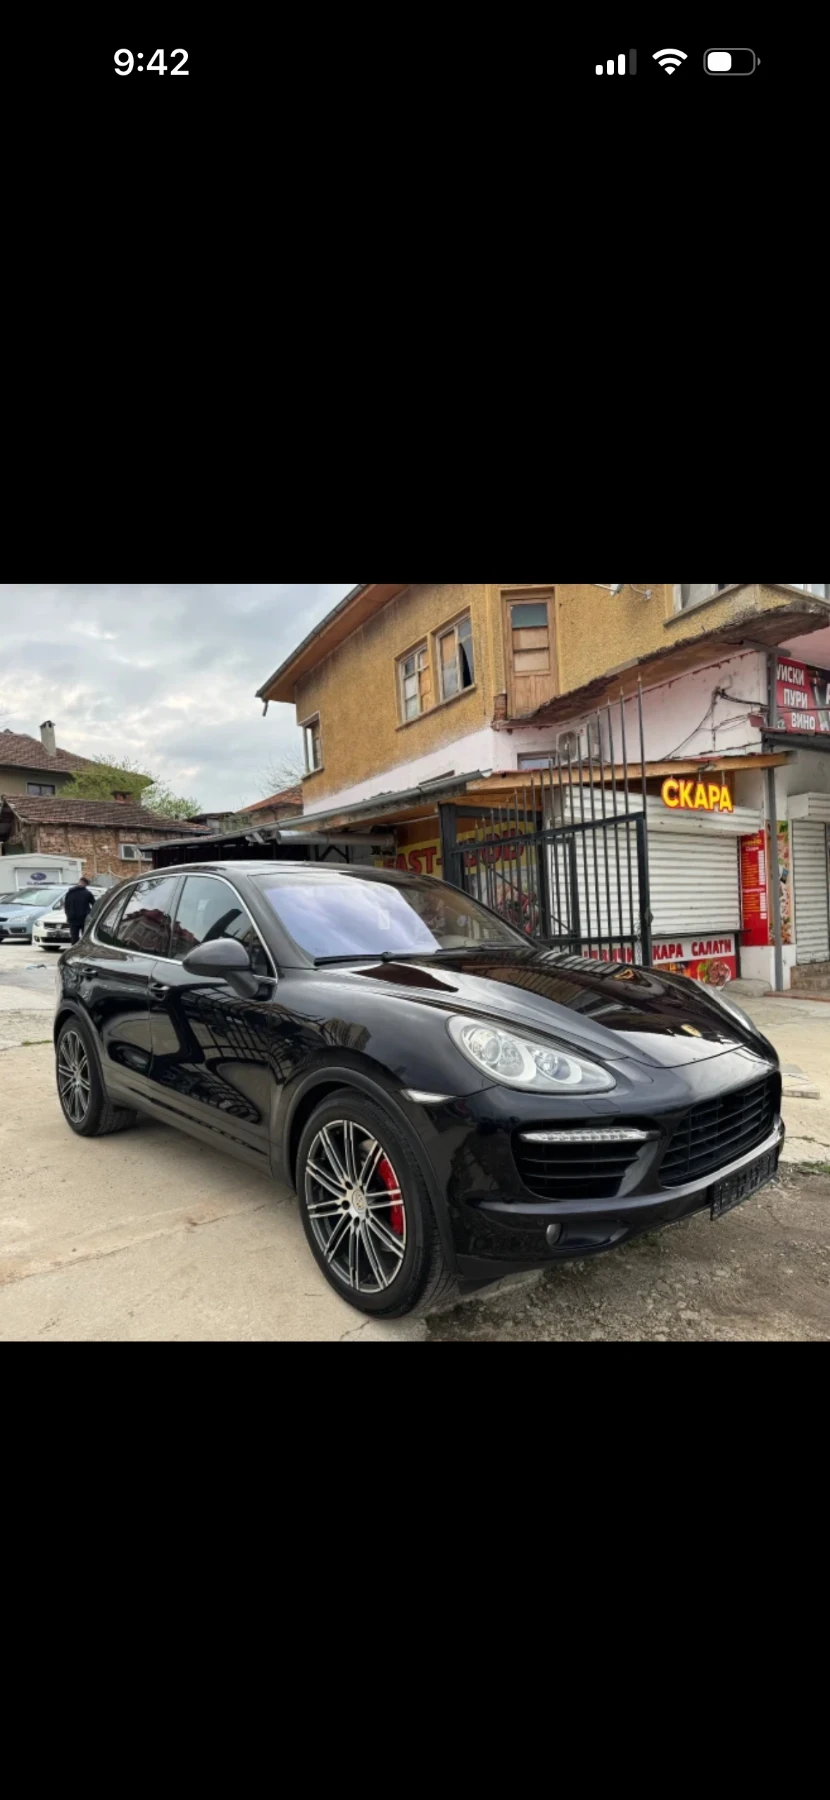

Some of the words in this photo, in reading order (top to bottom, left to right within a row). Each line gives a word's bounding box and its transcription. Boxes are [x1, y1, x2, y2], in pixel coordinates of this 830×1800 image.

[783, 687, 808, 710] ПУРИ
[791, 712, 816, 731] ВИНО
[662, 777, 734, 813] СКАРА
[652, 943, 684, 961] КАРА
[691, 938, 732, 957] САЛАТИ
